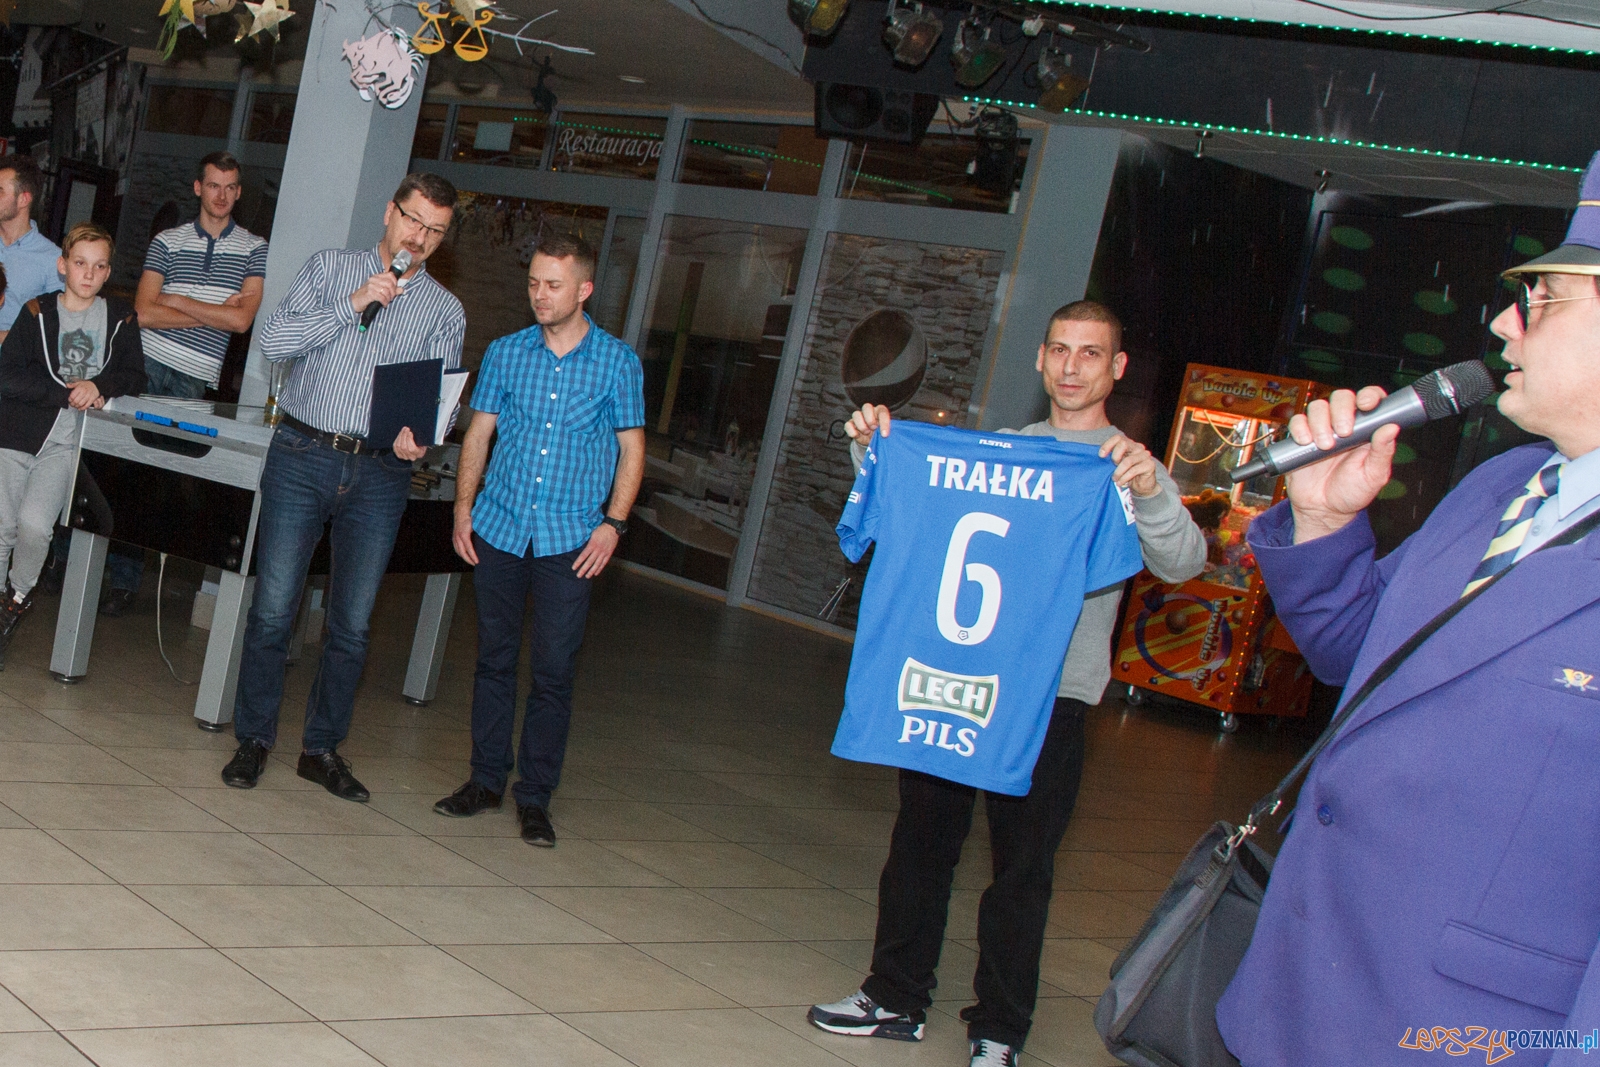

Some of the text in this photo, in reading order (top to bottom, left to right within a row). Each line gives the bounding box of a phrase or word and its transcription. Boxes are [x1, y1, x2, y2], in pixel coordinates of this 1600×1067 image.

[559, 128, 664, 166] Restauracja
[1202, 379, 1283, 404] Double Up
[926, 454, 1053, 503] TRAŁKA
[936, 511, 1011, 646] 6
[1199, 598, 1229, 662] Double
[908, 673, 988, 712] LECH
[897, 714, 977, 757] PILS
